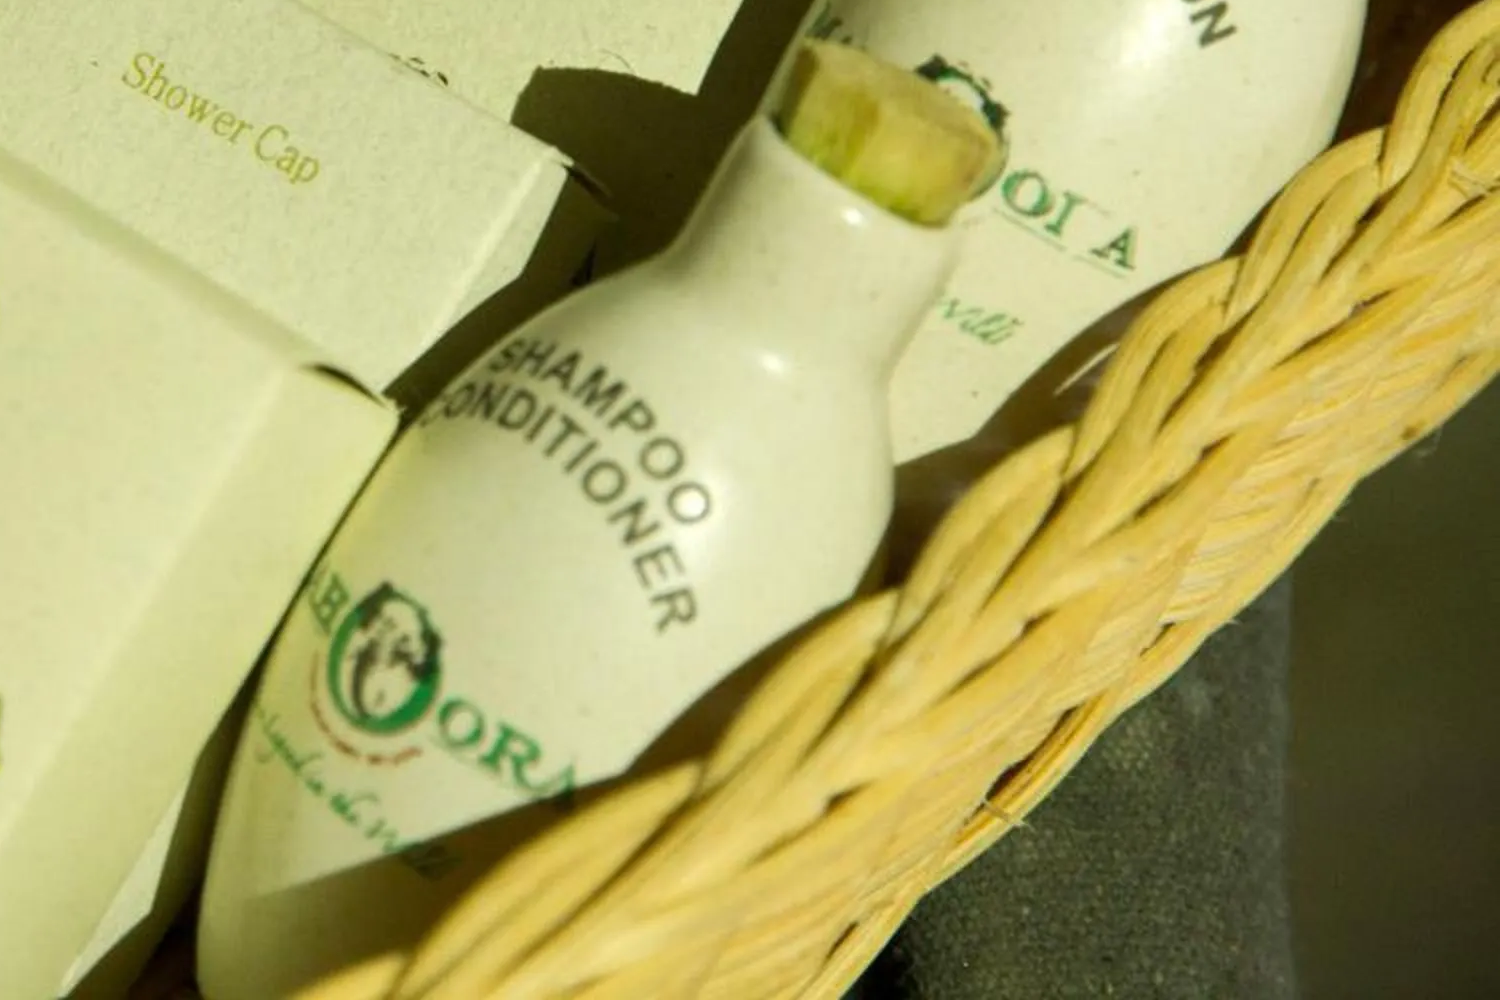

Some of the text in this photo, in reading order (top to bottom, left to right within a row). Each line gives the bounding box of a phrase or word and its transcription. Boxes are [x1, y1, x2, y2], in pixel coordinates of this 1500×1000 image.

[121, 53, 320, 184] Shower Cap
[489, 337, 711, 524] SHAMPOO
